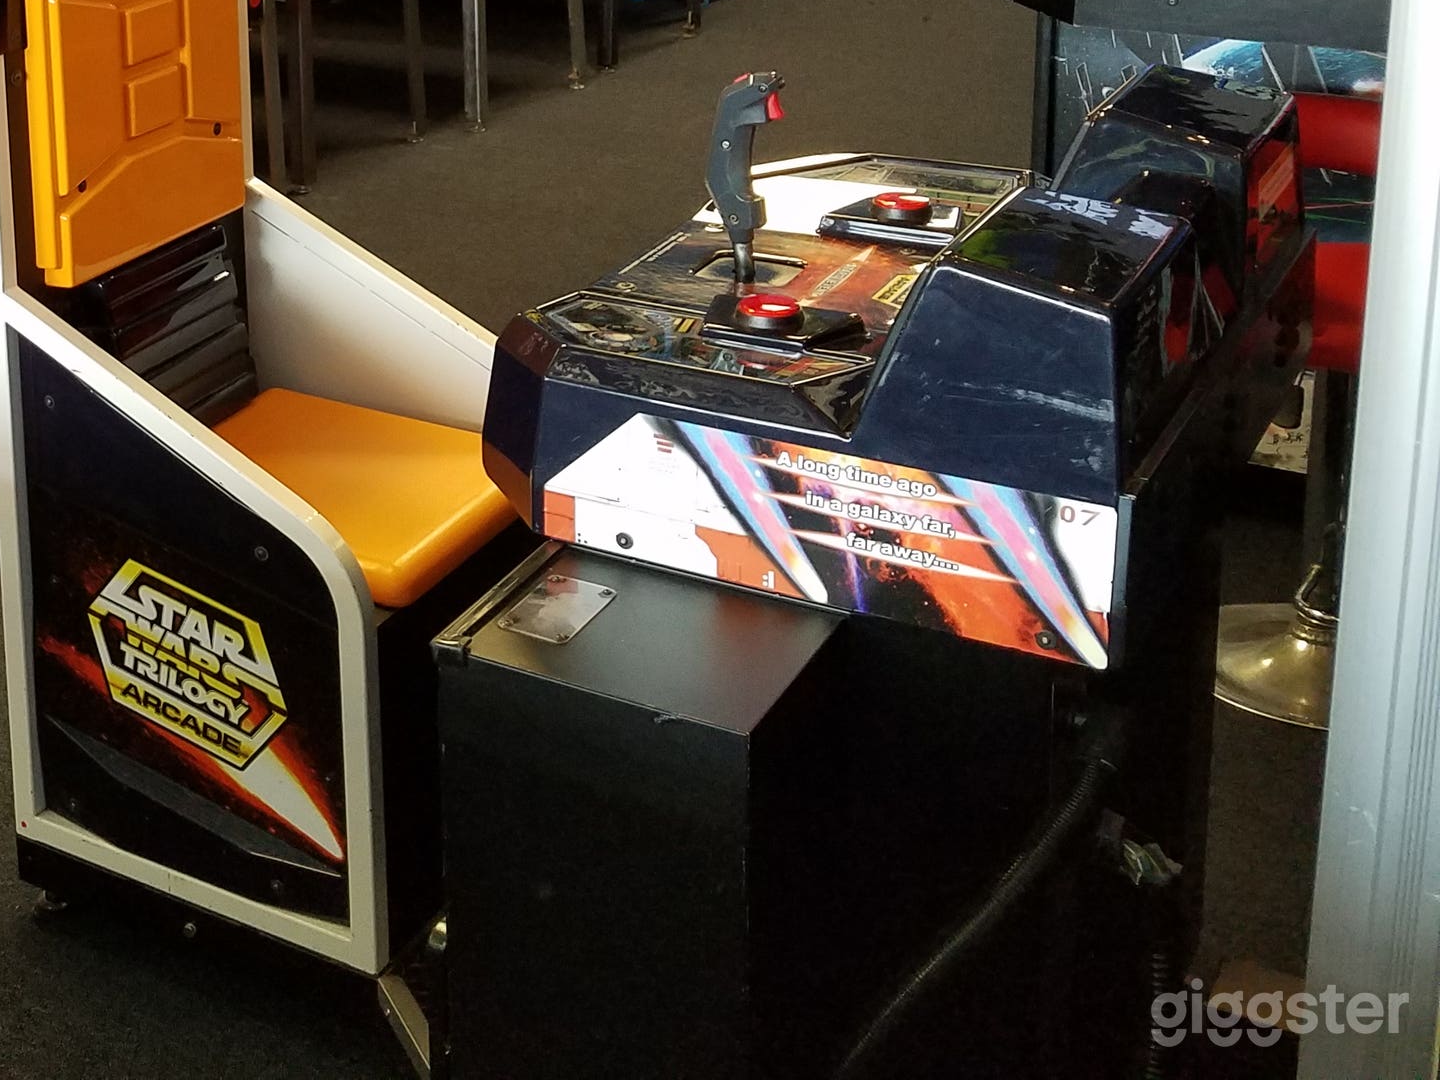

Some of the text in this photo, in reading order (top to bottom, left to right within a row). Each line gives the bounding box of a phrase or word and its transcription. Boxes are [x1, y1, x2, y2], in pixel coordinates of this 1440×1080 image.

[776, 451, 938, 498] A long time ago
[804, 489, 957, 539] in a galaxy far,
[1059, 503, 1102, 527] 07
[846, 531, 877, 553] far
[118, 583, 262, 666] STAR
[119, 640, 249, 726] TRILOGY
[121, 682, 242, 753] ARCADE
